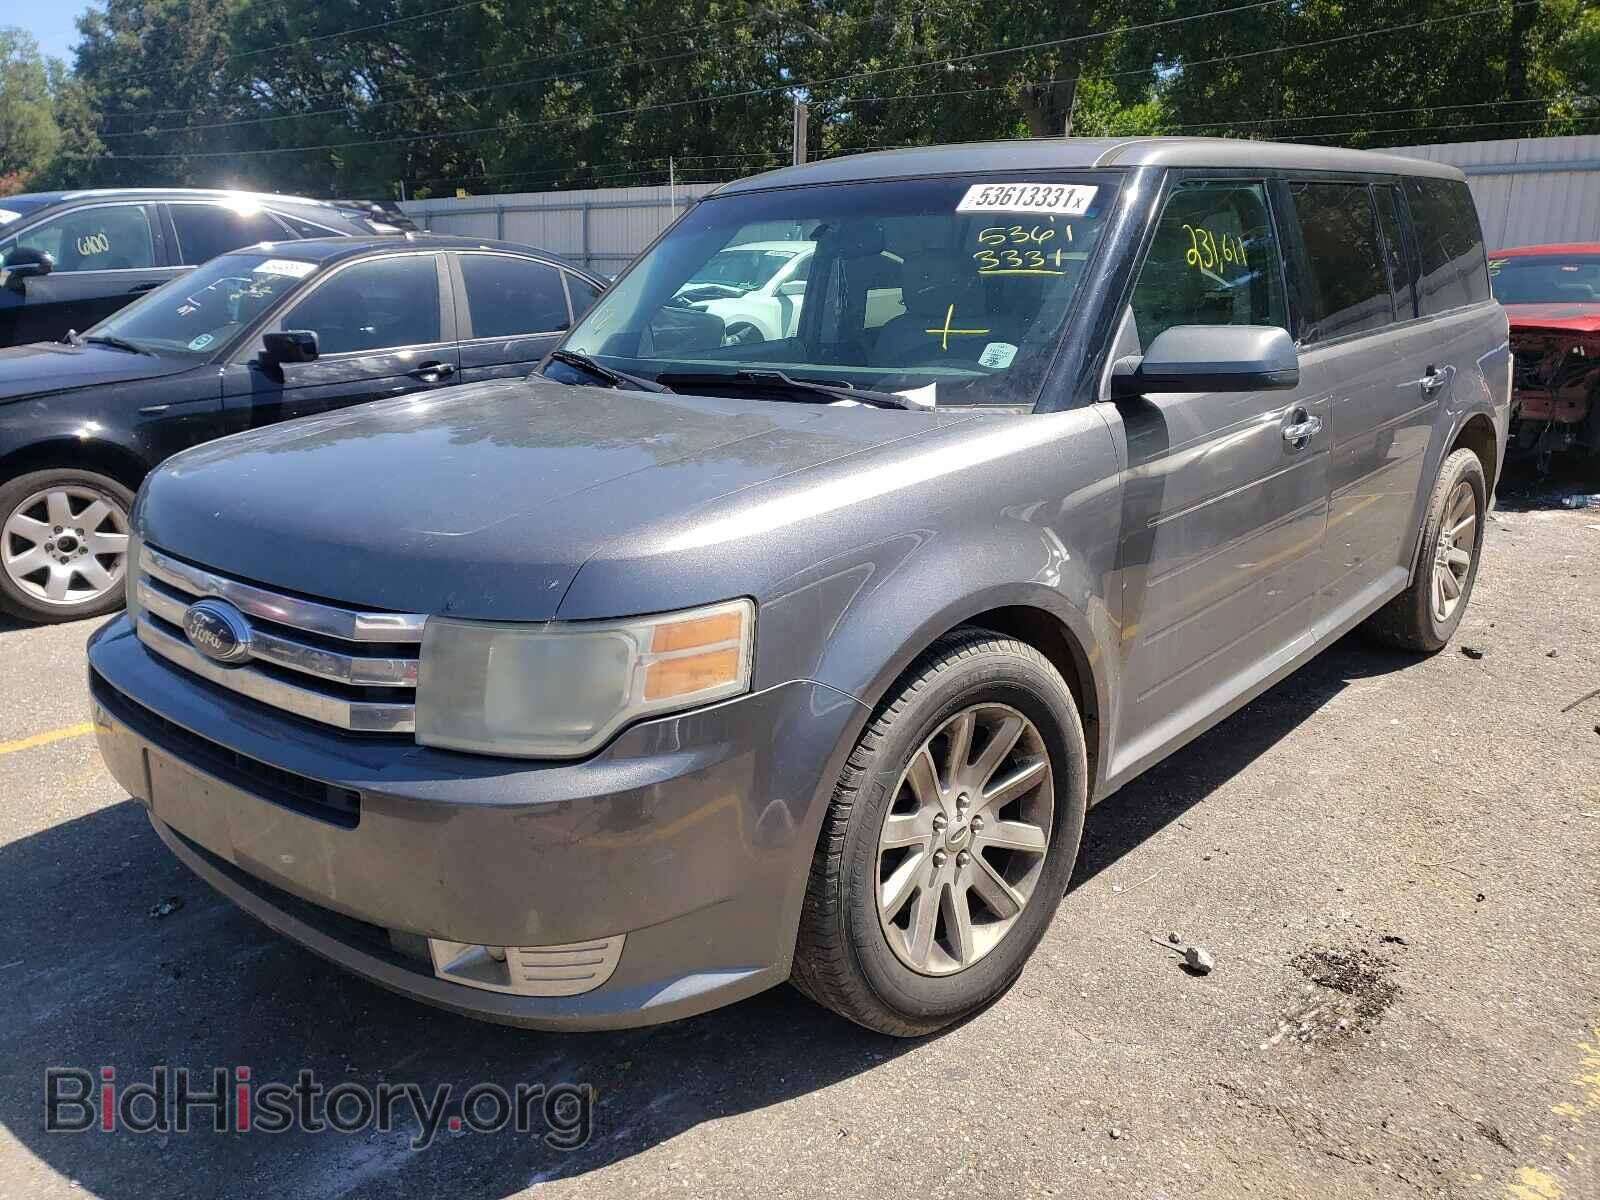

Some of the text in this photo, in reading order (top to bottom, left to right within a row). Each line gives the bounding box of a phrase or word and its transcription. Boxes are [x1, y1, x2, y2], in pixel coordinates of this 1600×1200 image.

[978, 224, 1073, 245] 5361
[973, 248, 1062, 269] 3331
[190, 612, 223, 649] Ford
